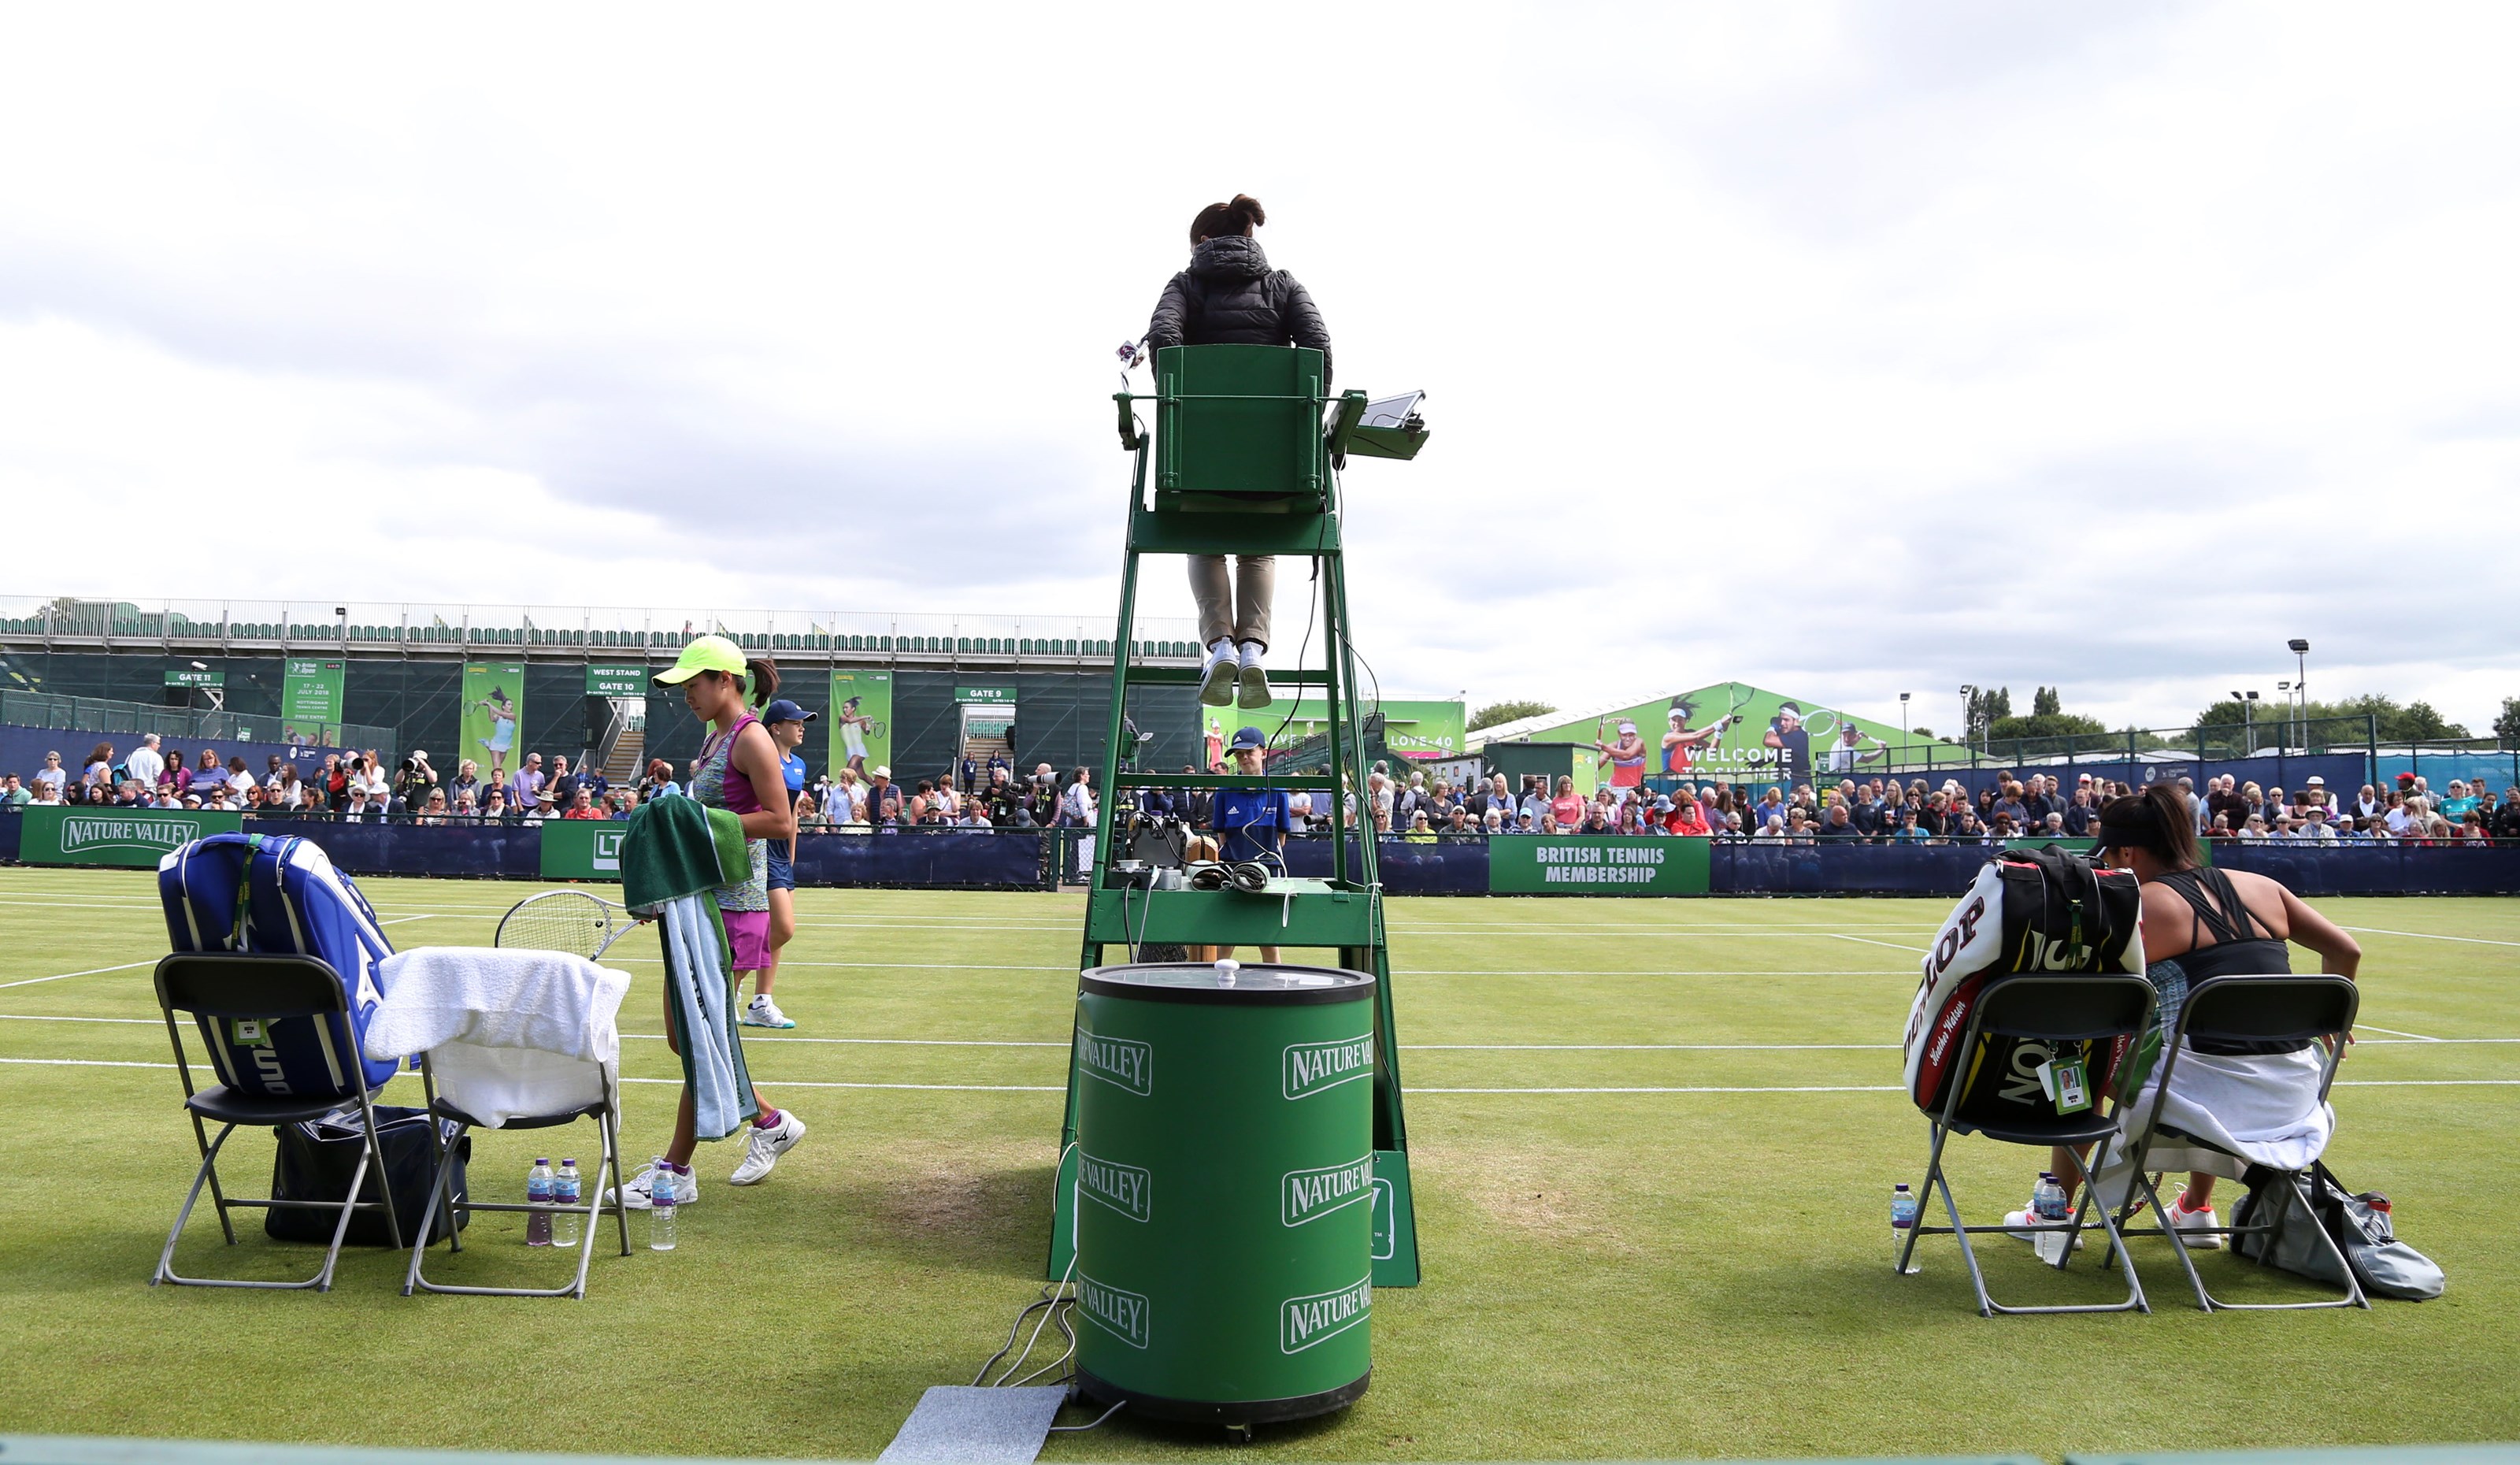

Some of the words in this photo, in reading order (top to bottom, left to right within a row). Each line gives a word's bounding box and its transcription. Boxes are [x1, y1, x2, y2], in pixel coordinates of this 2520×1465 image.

[1391, 736, 1453, 747] LOVE-40
[1684, 746, 1792, 763] WELCOME
[68, 821, 133, 847] NATURE
[135, 823, 195, 846] VALLEY
[598, 835, 627, 856] LT
[1536, 847, 1601, 863] BRITISH
[1606, 847, 1665, 864] TENNIS
[1545, 866, 1657, 883] MEMBERSHIP
[1943, 1000, 1966, 1033] Watson
[1088, 1040, 1146, 1087] VALLEY
[1292, 1044, 1361, 1091] NATURE
[1087, 1160, 1144, 1213] VALLEY
[1291, 1166, 1360, 1218] NATURE
[1087, 1283, 1143, 1339] VALLEY
[1290, 1289, 1358, 1345] NATURE
